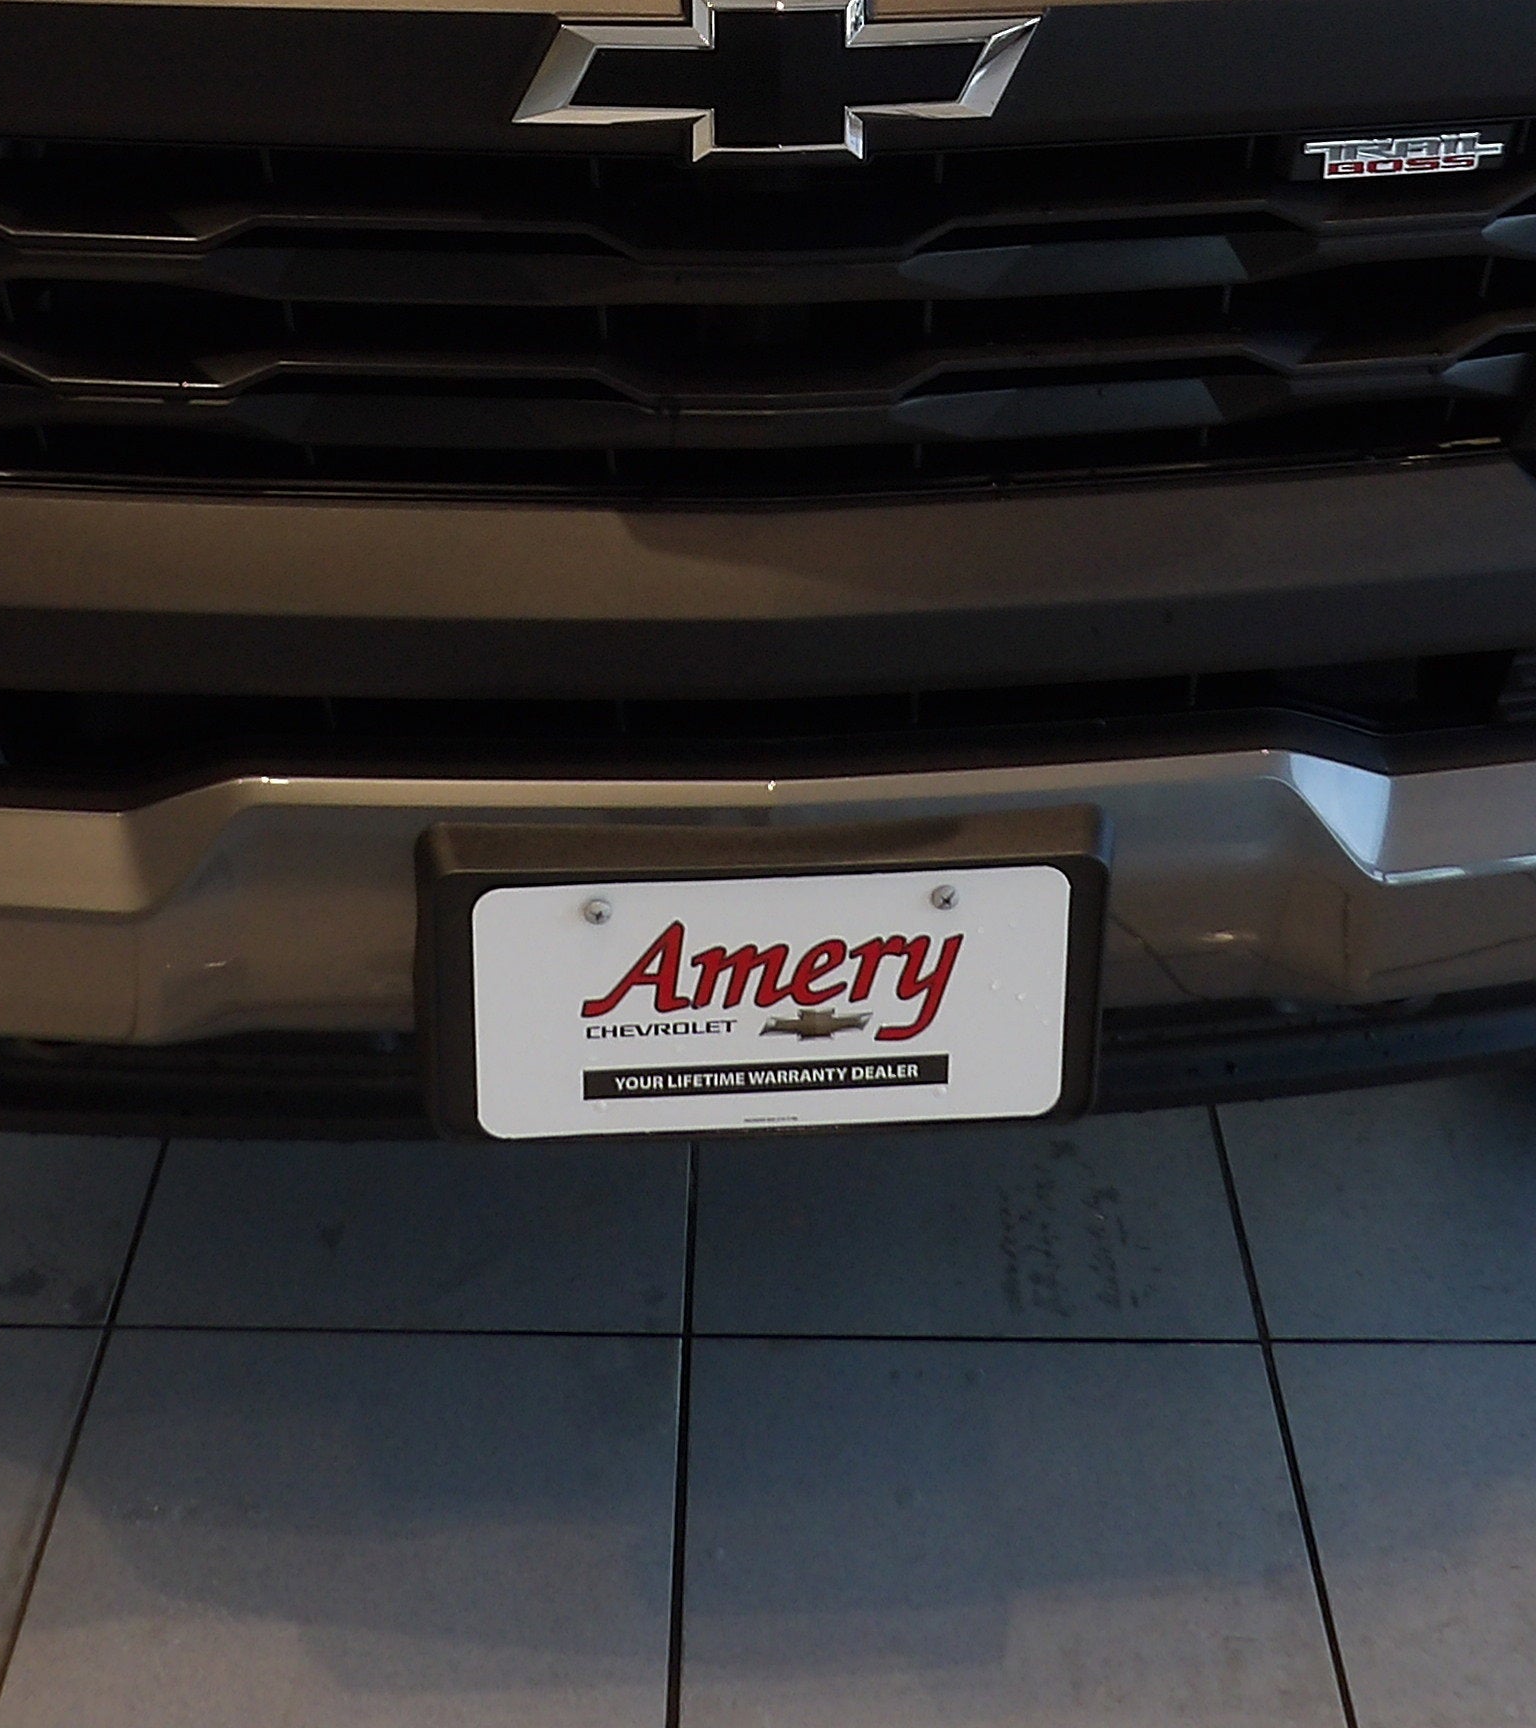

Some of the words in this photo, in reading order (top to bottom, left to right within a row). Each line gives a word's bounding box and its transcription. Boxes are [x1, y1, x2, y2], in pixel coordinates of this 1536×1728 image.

[1304, 132, 1504, 160] TRAIL
[1327, 155, 1475, 176] BOSS
[581, 920, 964, 1041] Amery
[586, 1019, 737, 1039] CHEVROLET
[615, 1075, 664, 1091] YOUR
[667, 1072, 745, 1089] LIFETIME
[748, 1066, 848, 1085] WARRANTY
[851, 1064, 919, 1080] DEALER
